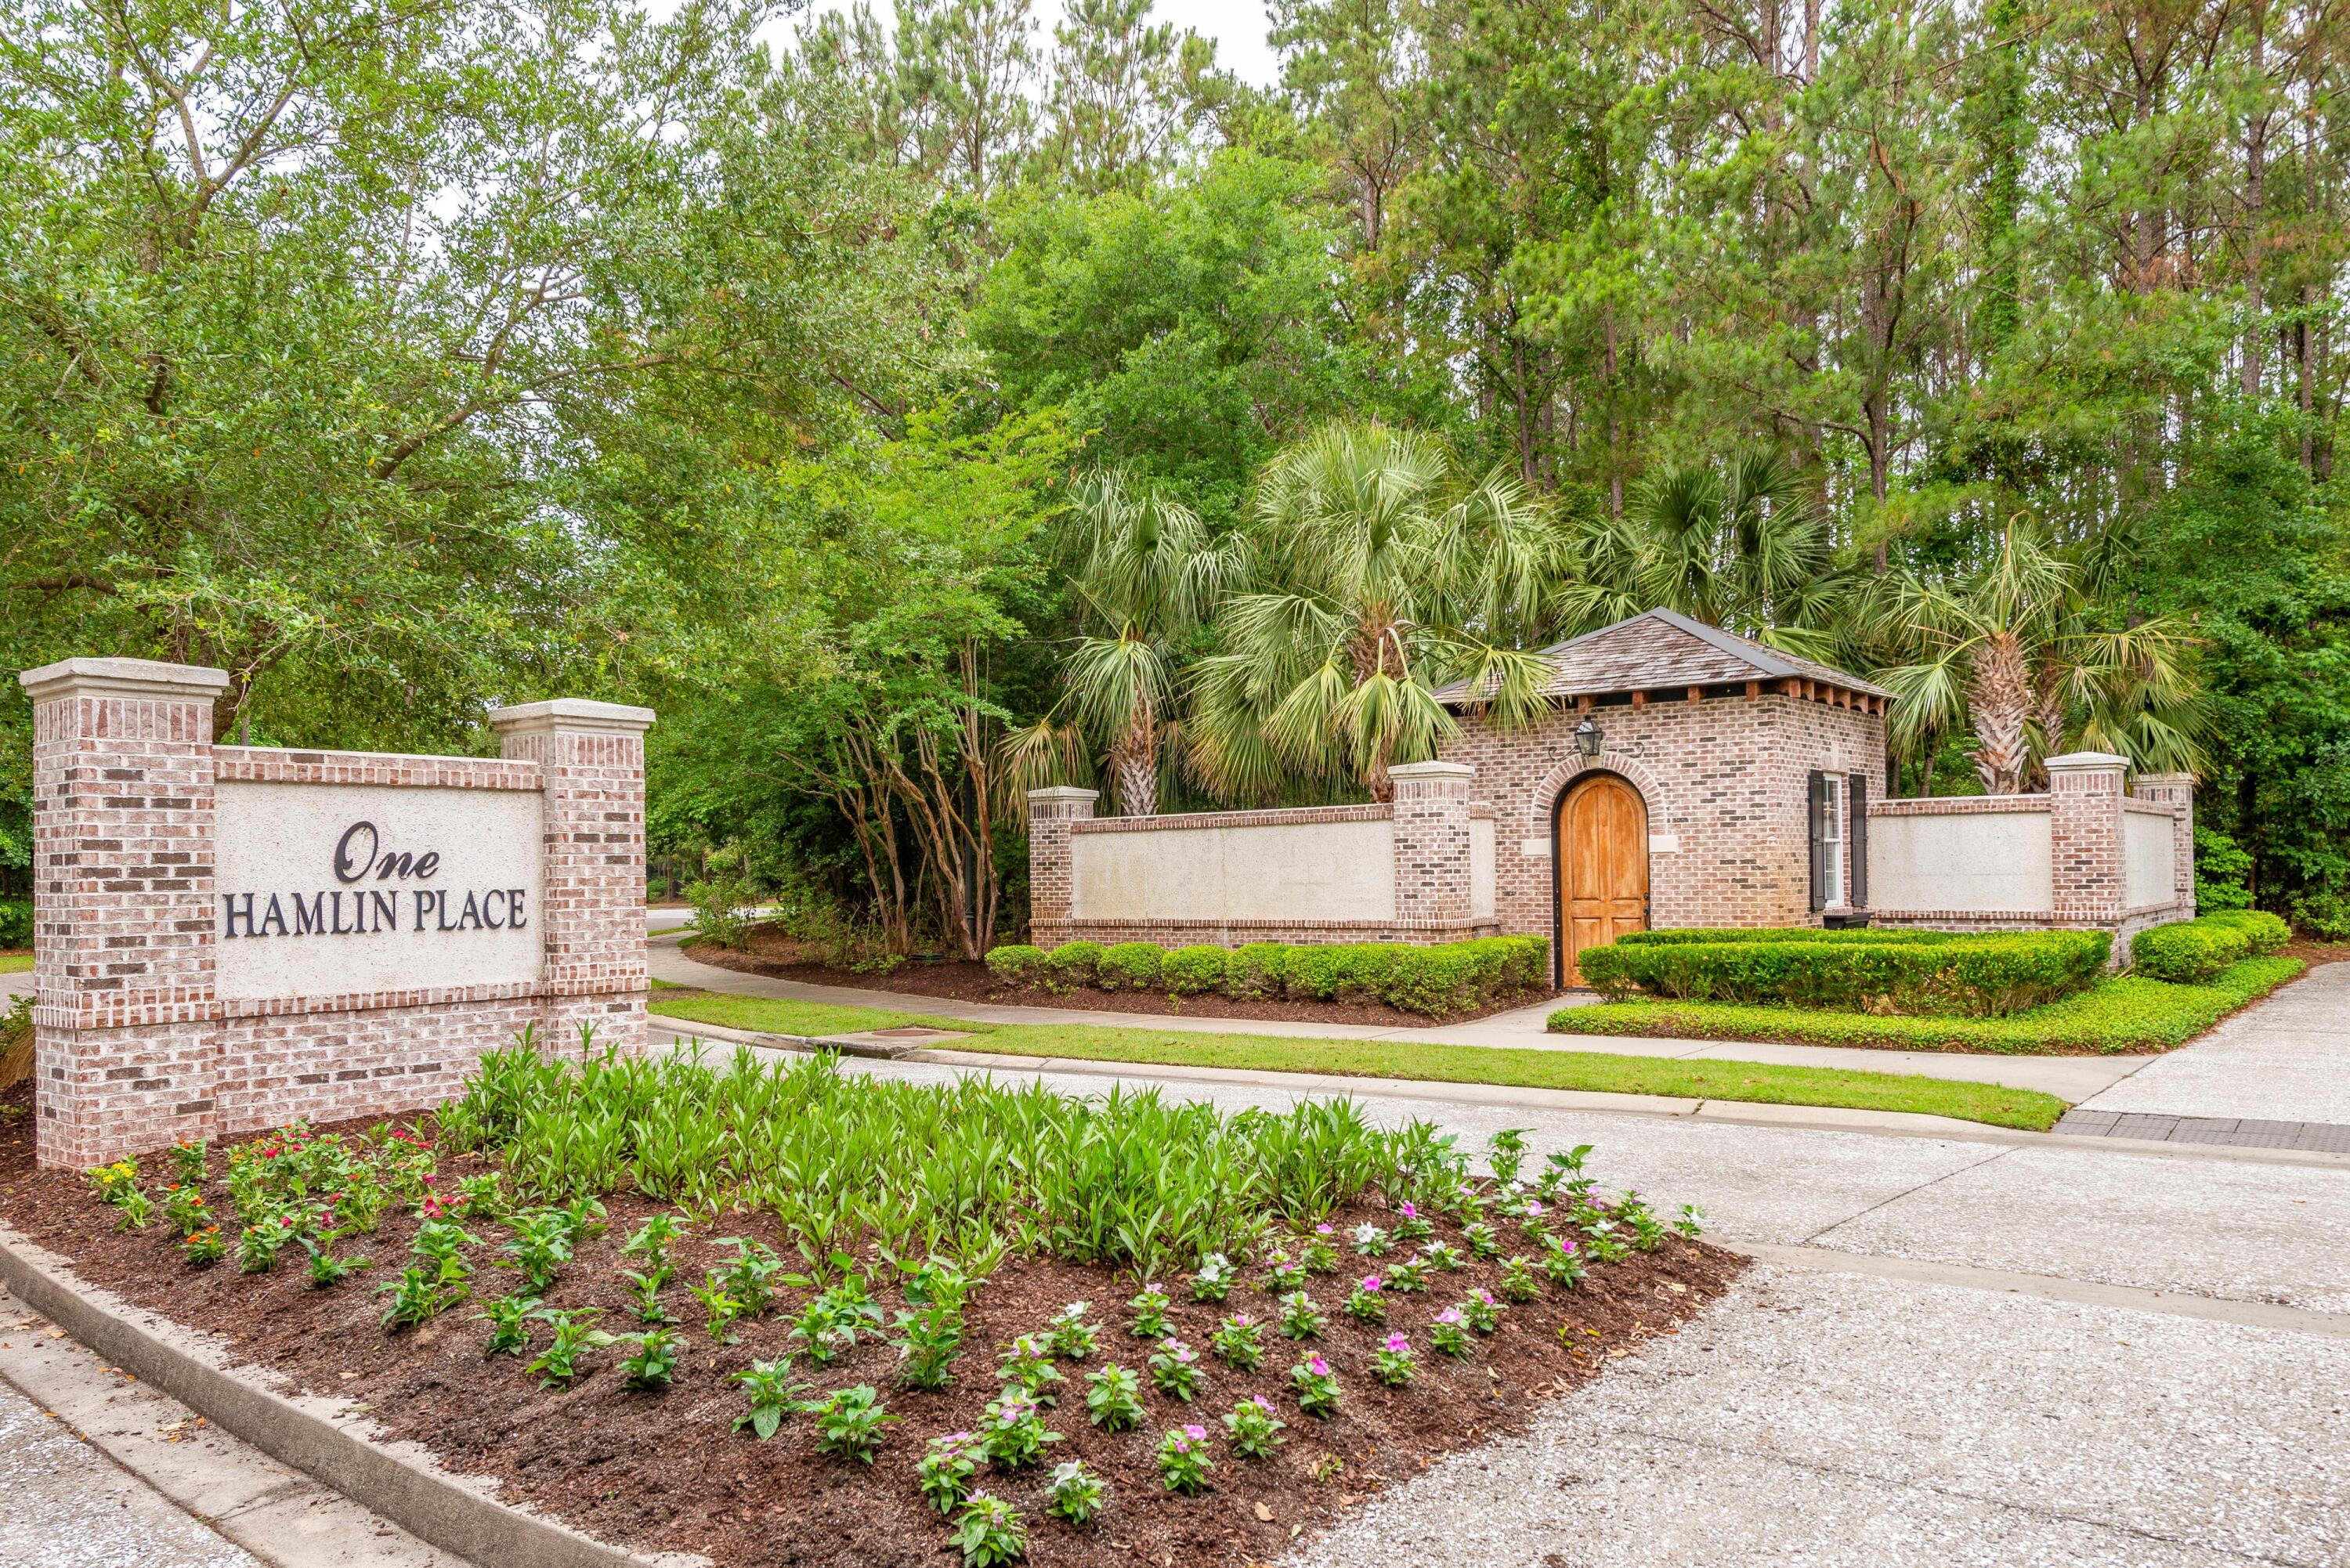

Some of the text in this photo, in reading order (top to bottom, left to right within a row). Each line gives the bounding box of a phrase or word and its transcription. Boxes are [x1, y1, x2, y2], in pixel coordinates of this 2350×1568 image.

[334, 820, 440, 883] One
[222, 889, 527, 939] HAMLIN PLACE
